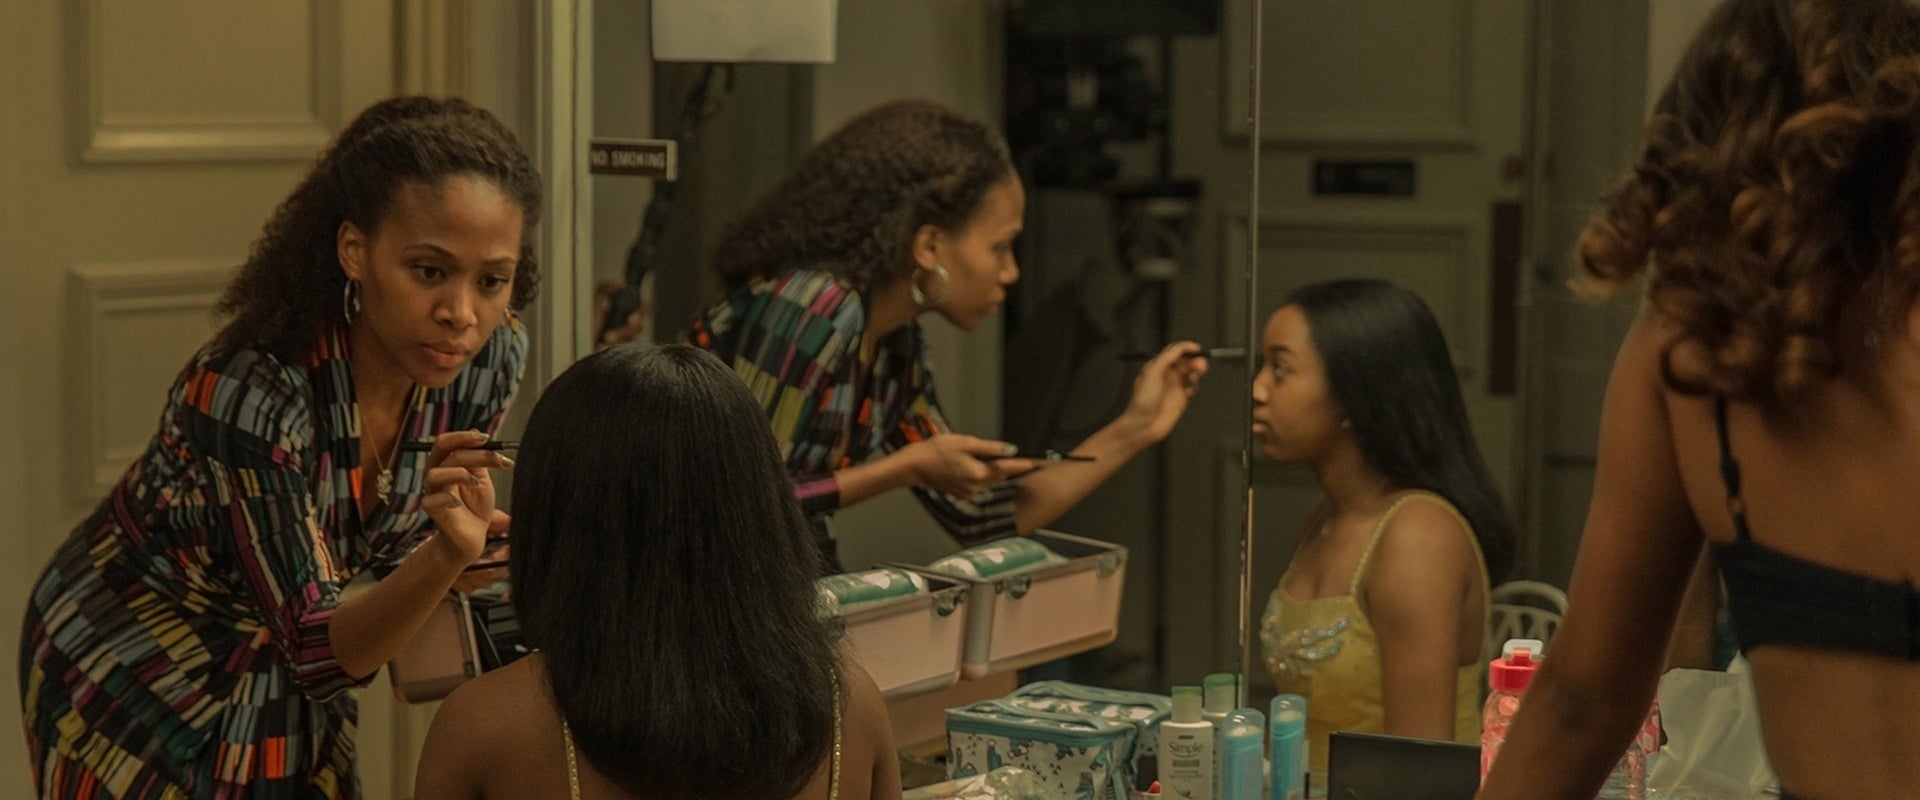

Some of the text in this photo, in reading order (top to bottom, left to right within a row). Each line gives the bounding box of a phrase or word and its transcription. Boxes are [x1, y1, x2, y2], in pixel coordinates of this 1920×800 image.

[591, 150, 666, 169] NO SMOKING
[1168, 741, 1203, 754] Simple
